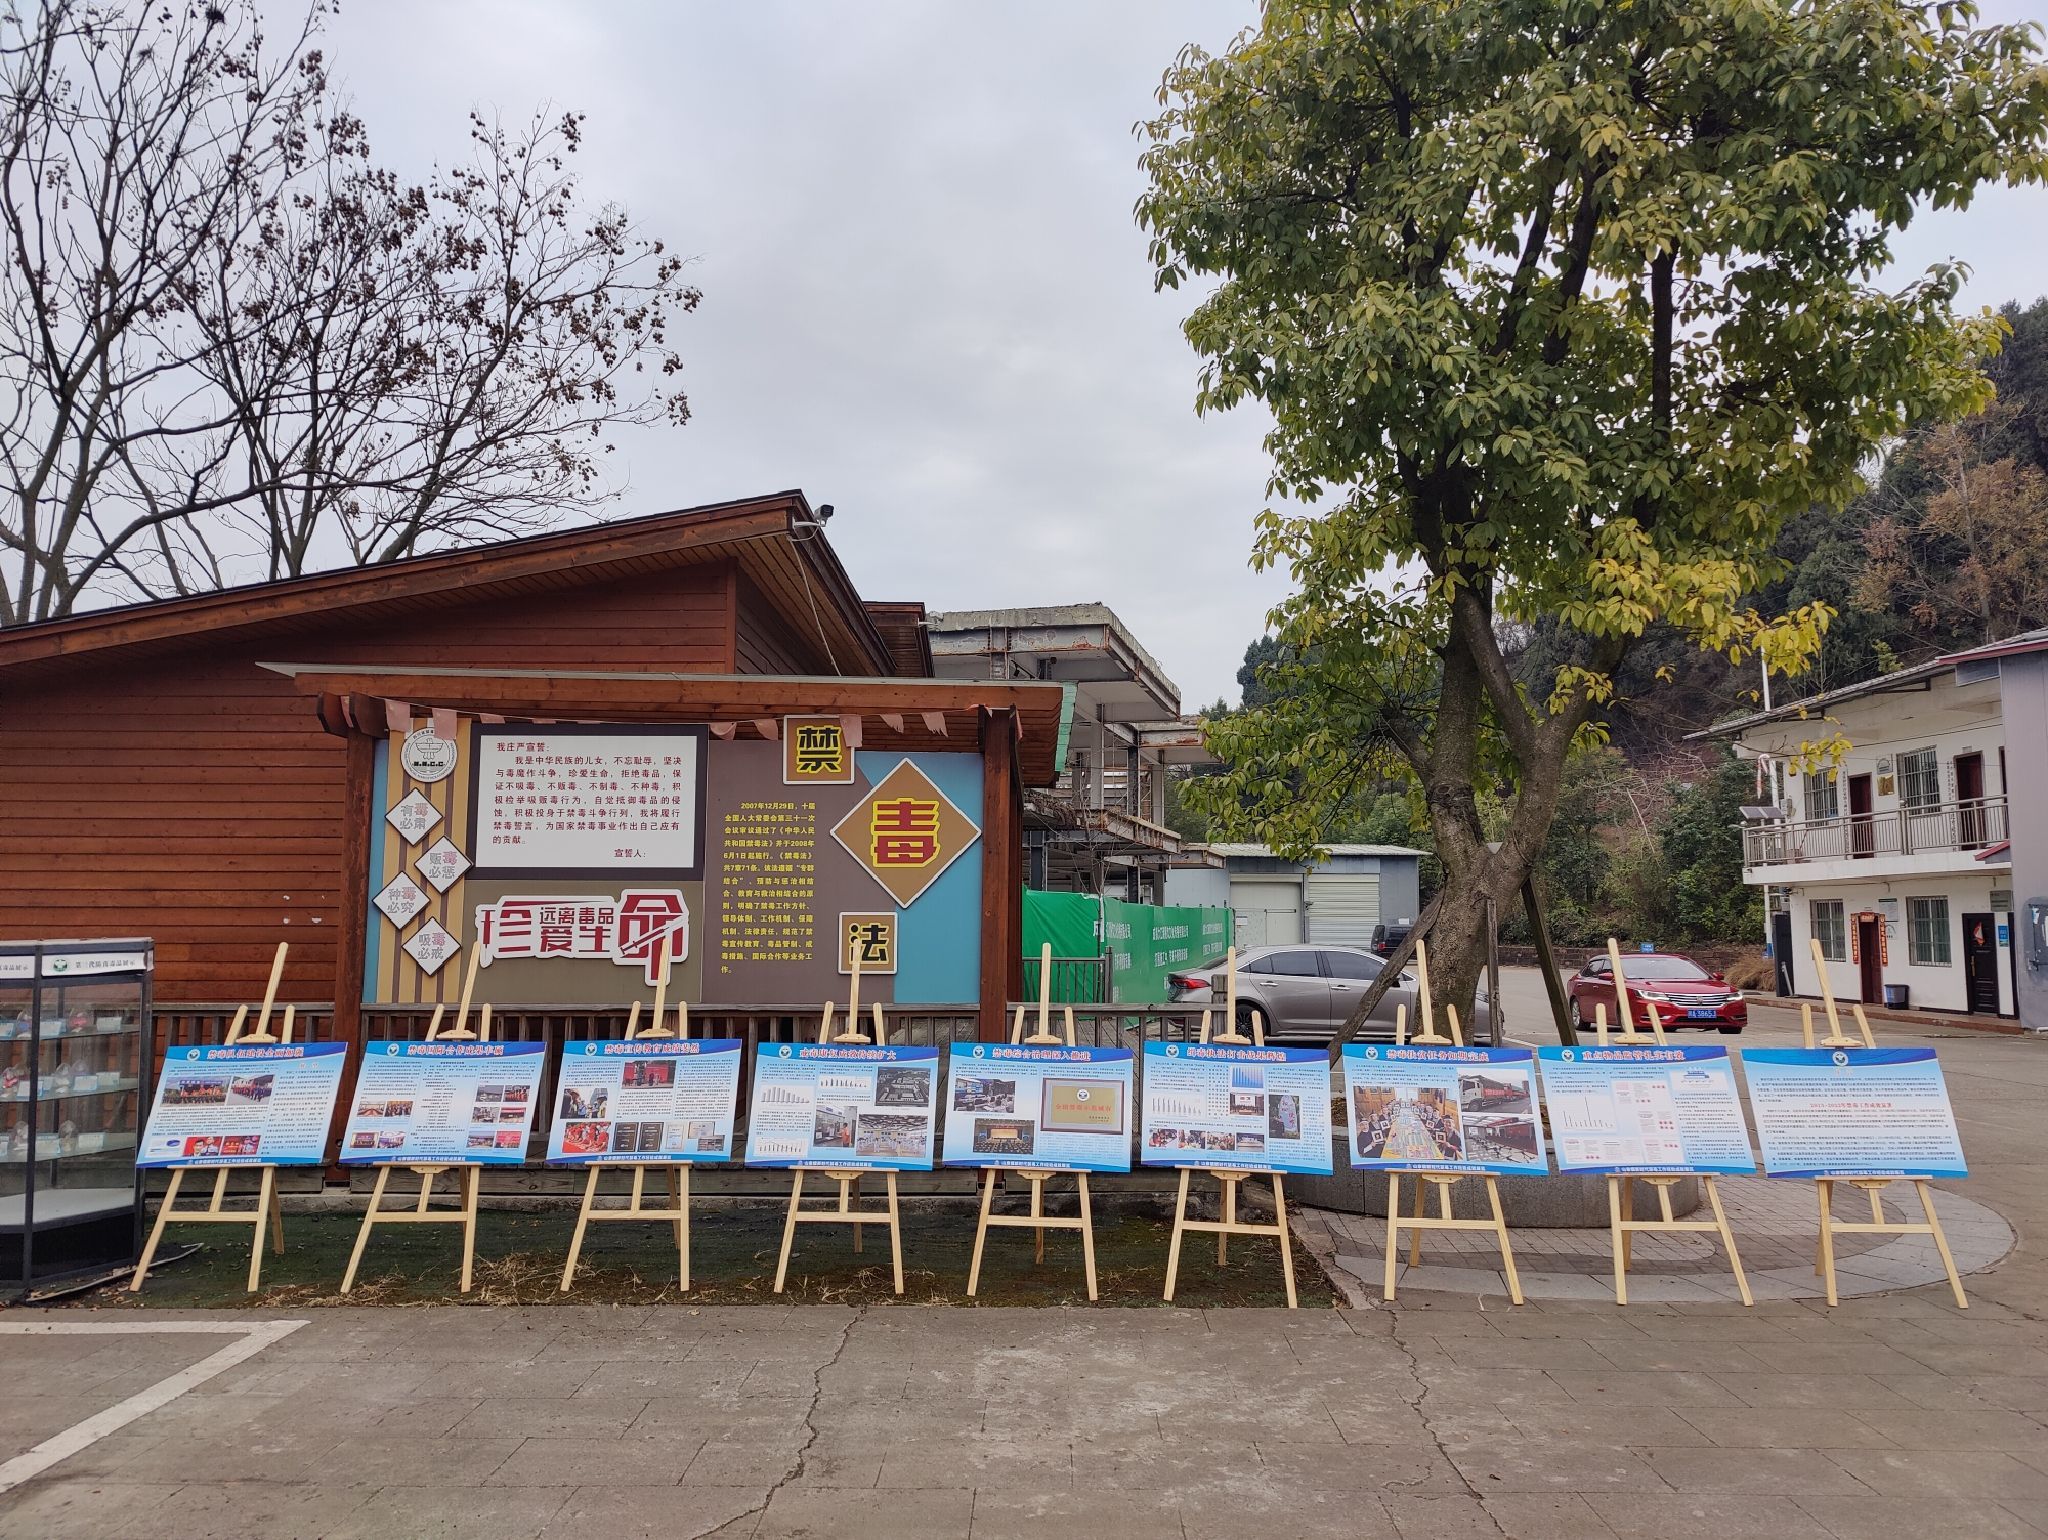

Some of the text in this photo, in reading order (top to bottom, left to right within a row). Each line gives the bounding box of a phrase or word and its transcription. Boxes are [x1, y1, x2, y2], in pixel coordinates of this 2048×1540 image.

[796, 725, 843, 774] 禁
[539, 907, 615, 925] 远离毒品
[848, 922, 889, 966] 法
